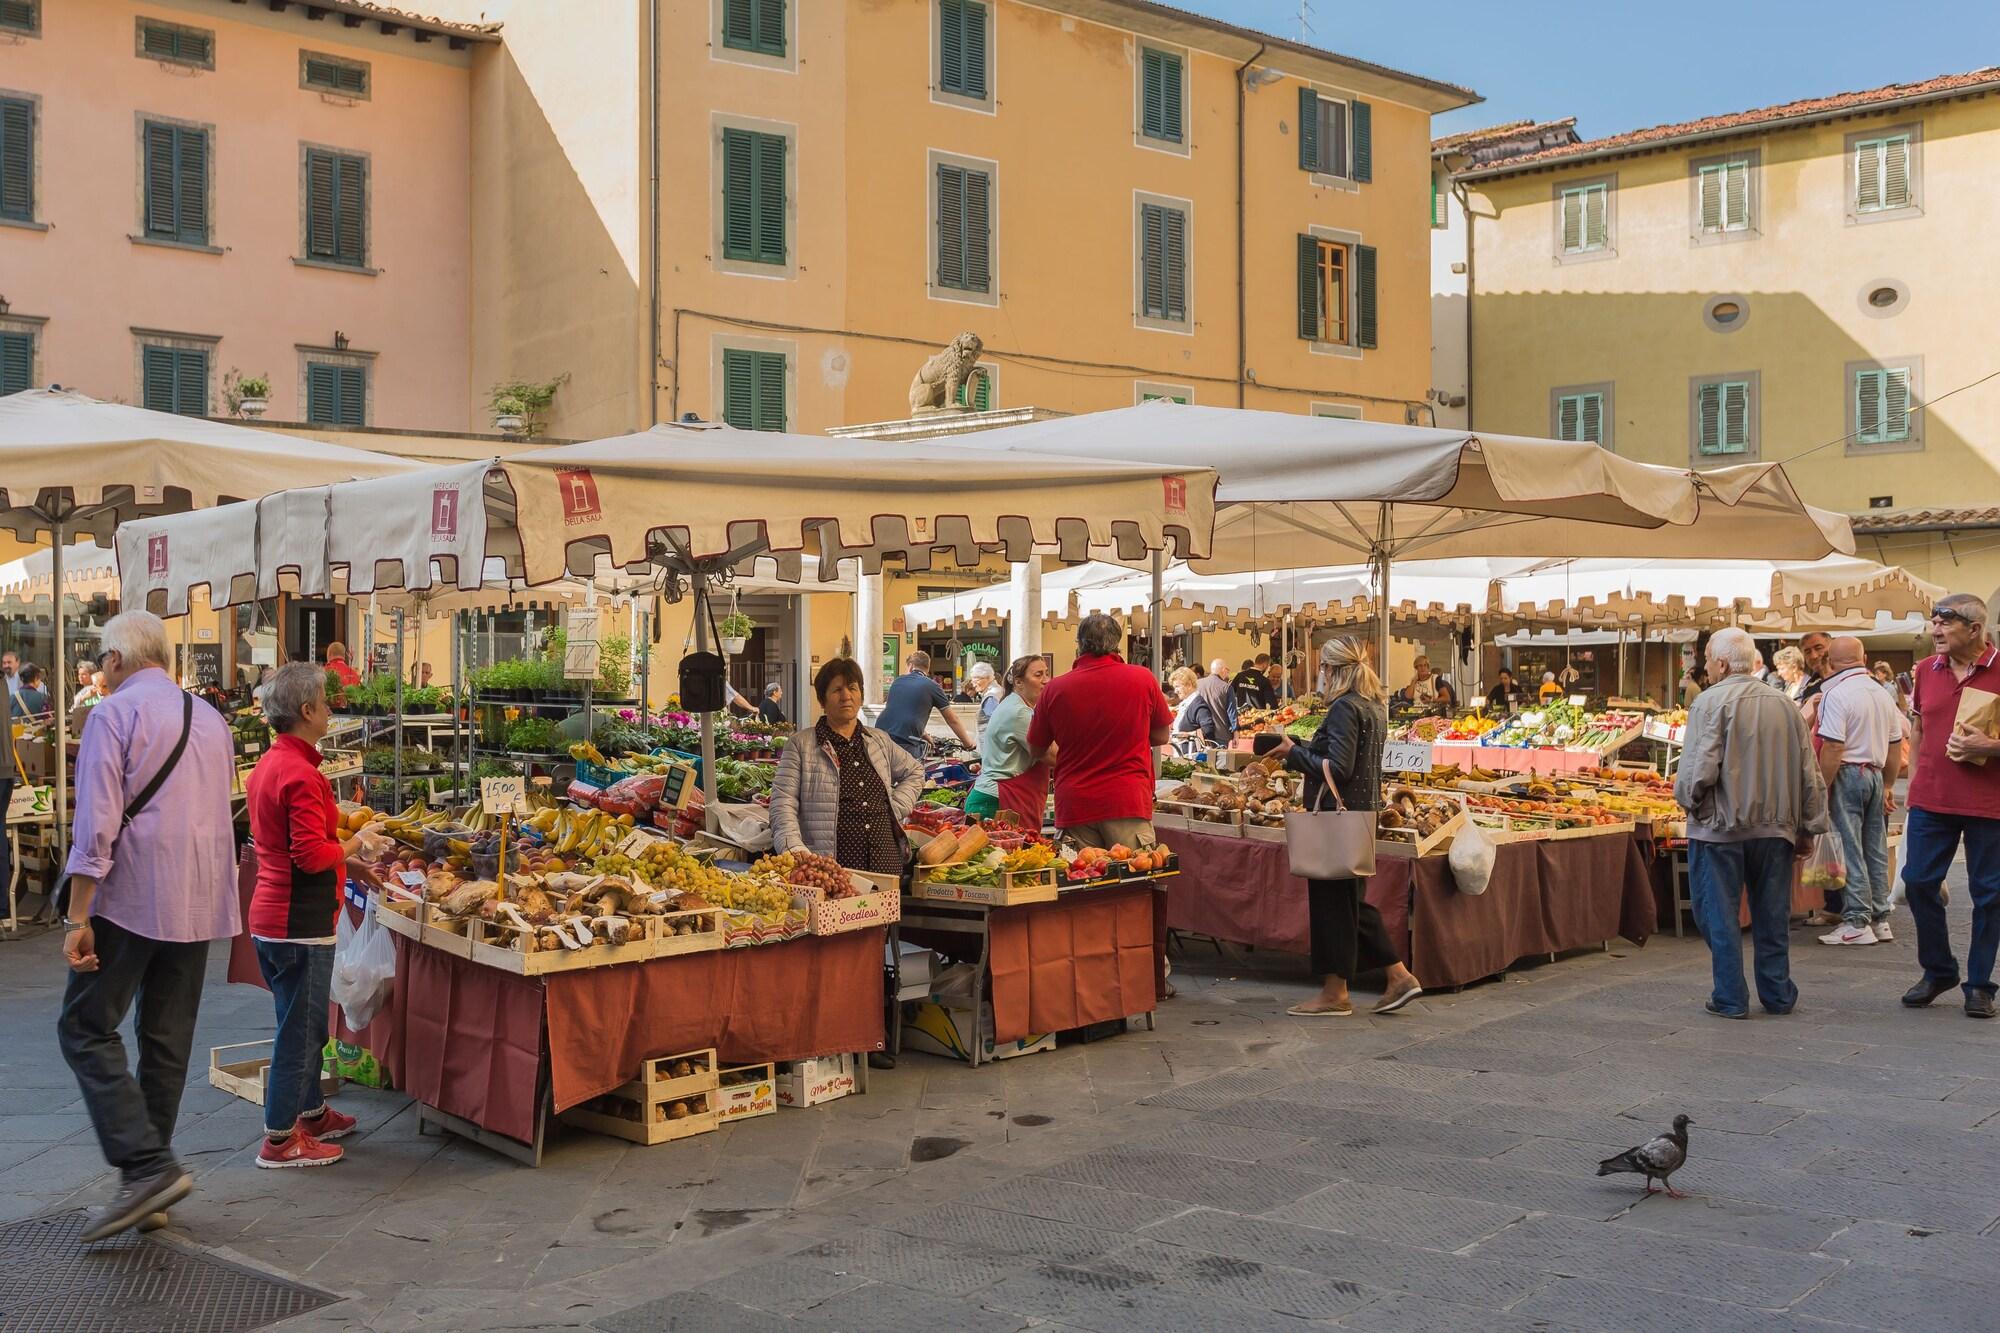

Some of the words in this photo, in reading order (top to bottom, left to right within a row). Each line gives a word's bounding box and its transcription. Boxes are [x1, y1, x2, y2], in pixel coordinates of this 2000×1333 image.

[565, 517, 584, 526] DELLA
[586, 513, 603, 523] SALA
[960, 642, 999, 657] CIPOLLARI
[927, 886, 954, 897] Prodotto
[840, 908, 879, 924] Seedless
[729, 1103, 748, 1114] delle
[750, 1098, 773, 1112] Puglie
